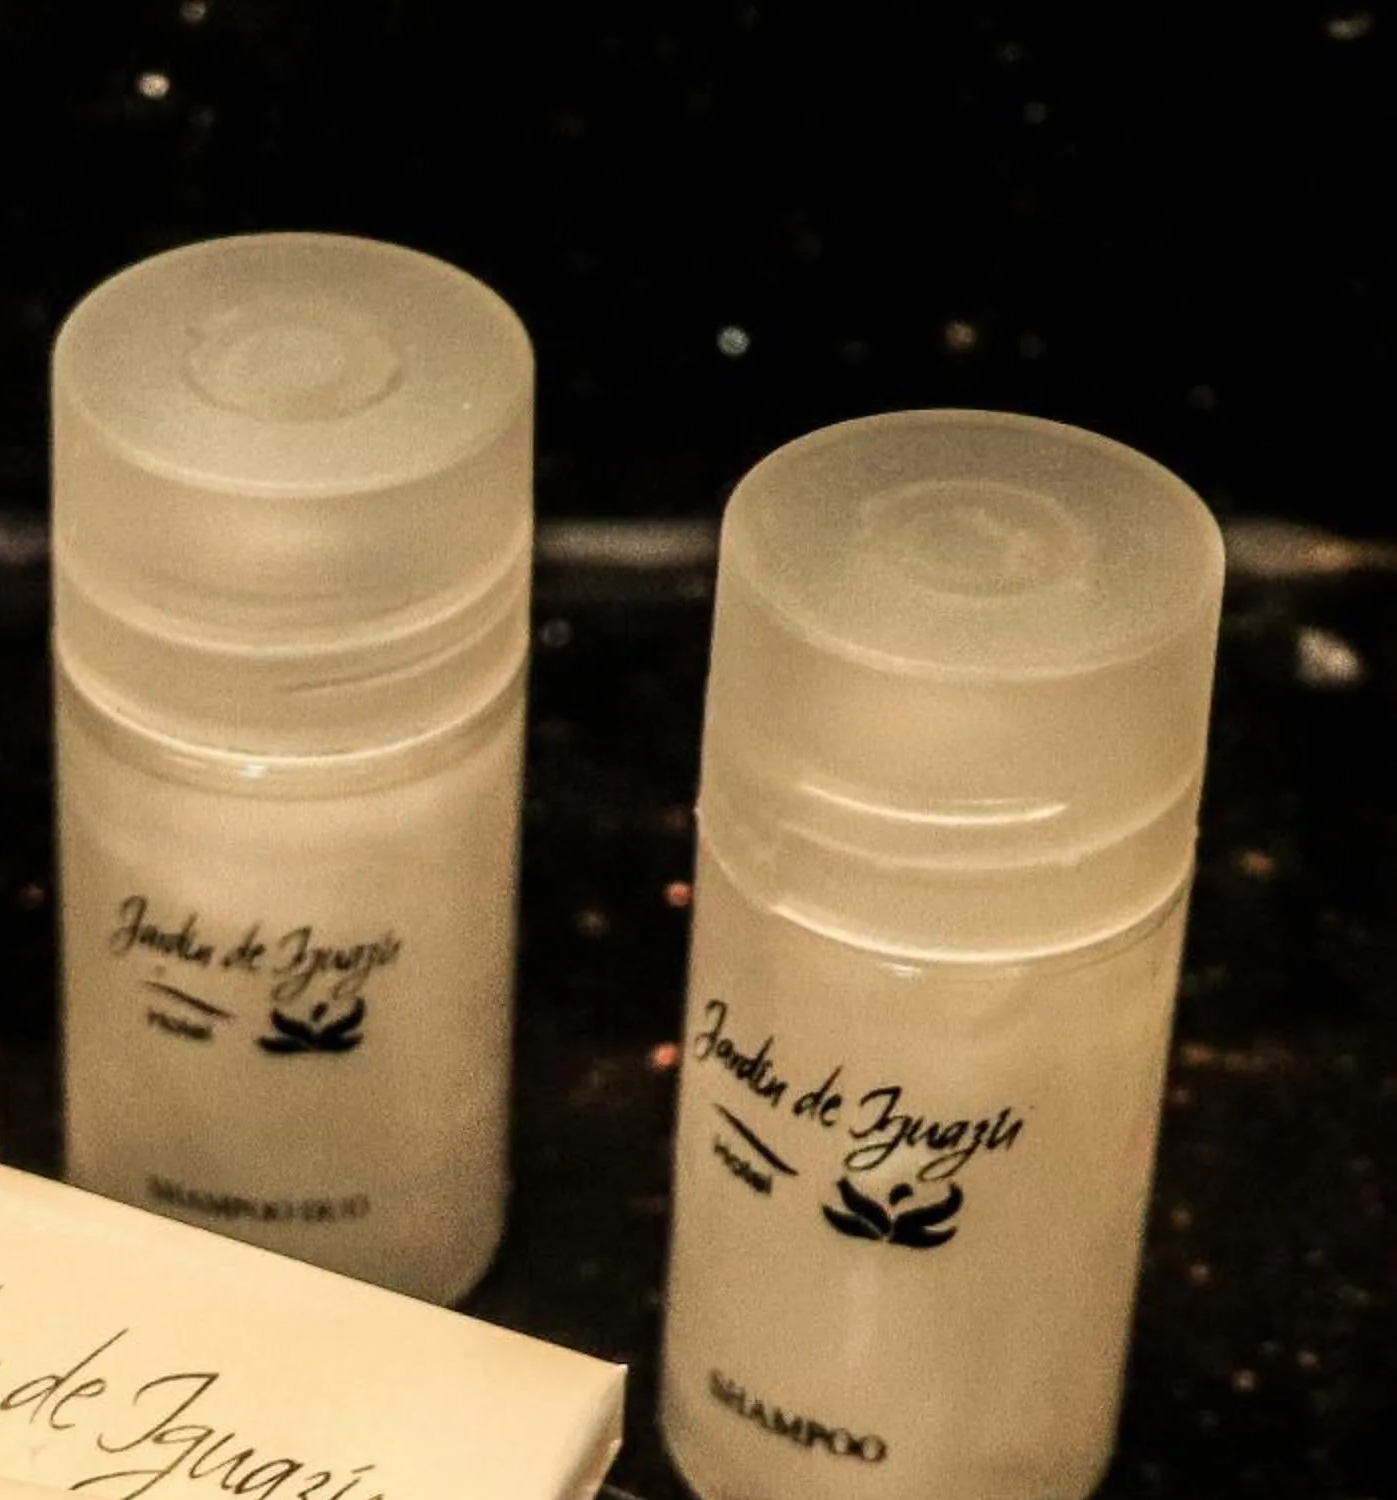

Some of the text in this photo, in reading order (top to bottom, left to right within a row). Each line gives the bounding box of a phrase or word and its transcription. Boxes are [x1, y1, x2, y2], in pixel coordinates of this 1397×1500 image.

[792, 1065, 843, 1127] de
[0, 1328, 129, 1430] de
[710, 1369, 887, 1463] SHAMPOO
